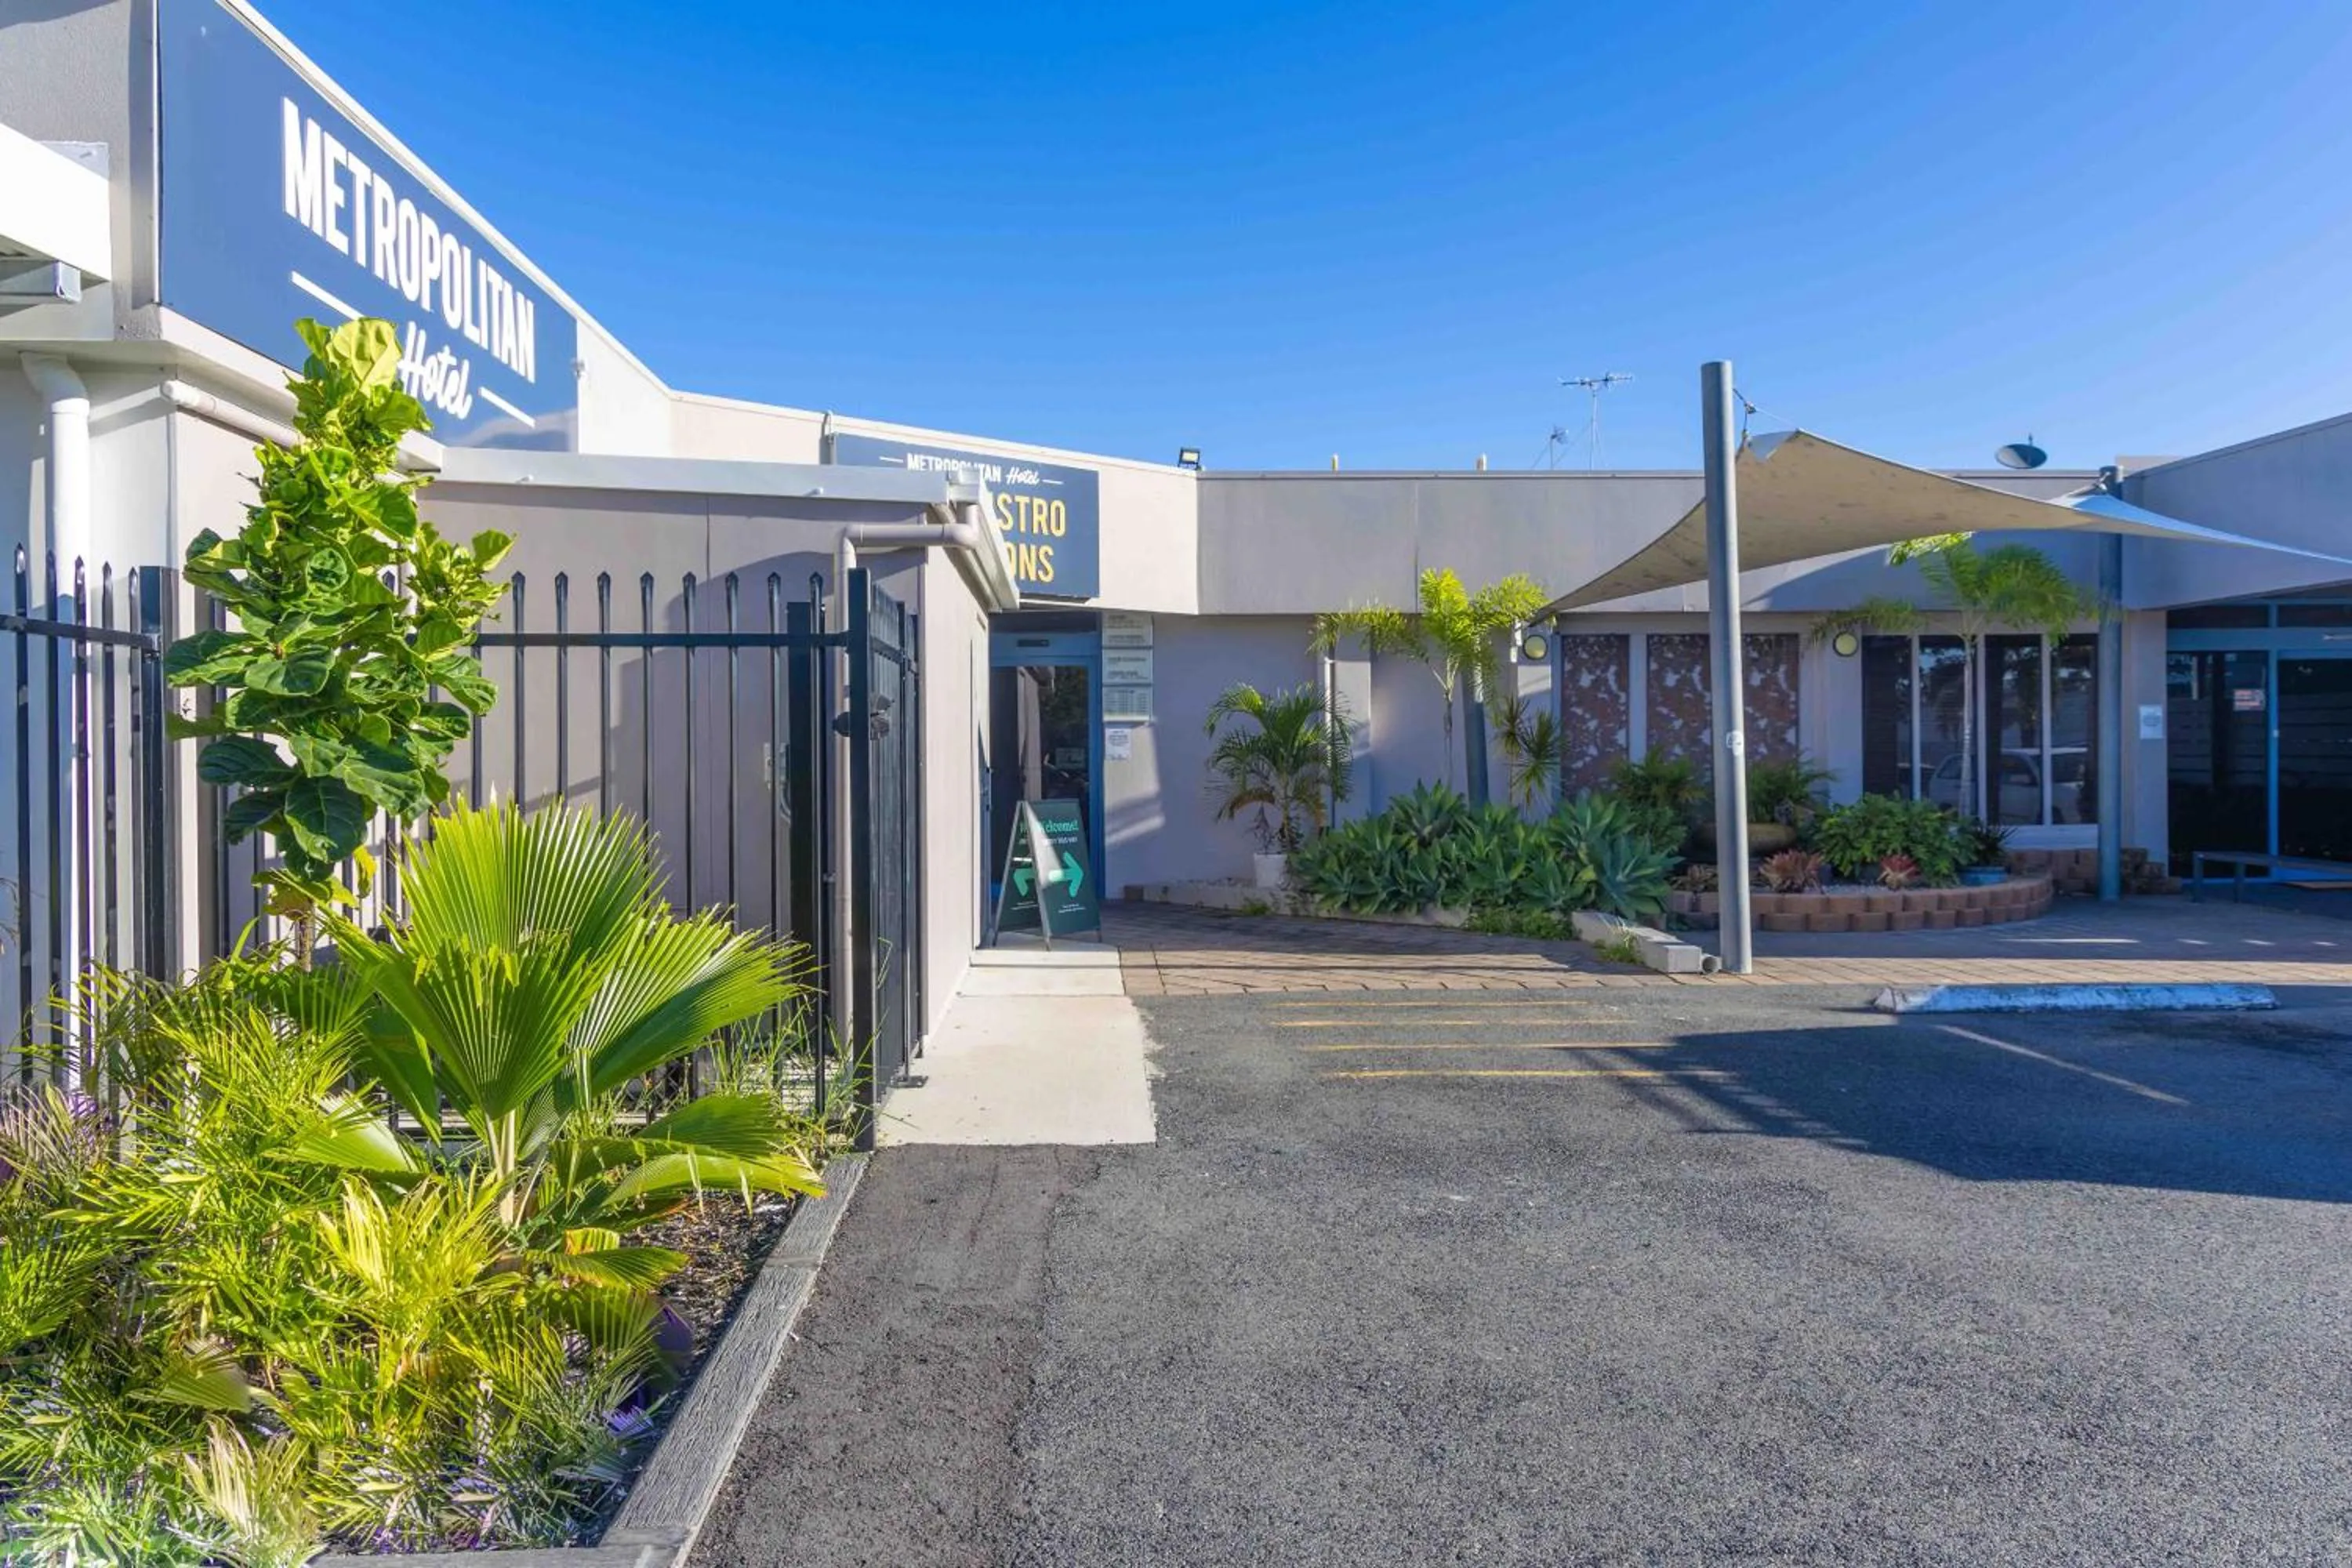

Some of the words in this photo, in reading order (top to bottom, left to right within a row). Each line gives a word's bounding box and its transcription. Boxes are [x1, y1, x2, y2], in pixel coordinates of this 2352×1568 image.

[283, 96, 535, 384] METROPOLITAN
[397, 321, 473, 420] Hotel
[1006, 466, 1041, 485] Hotel
[989, 492, 1066, 537] STRO
